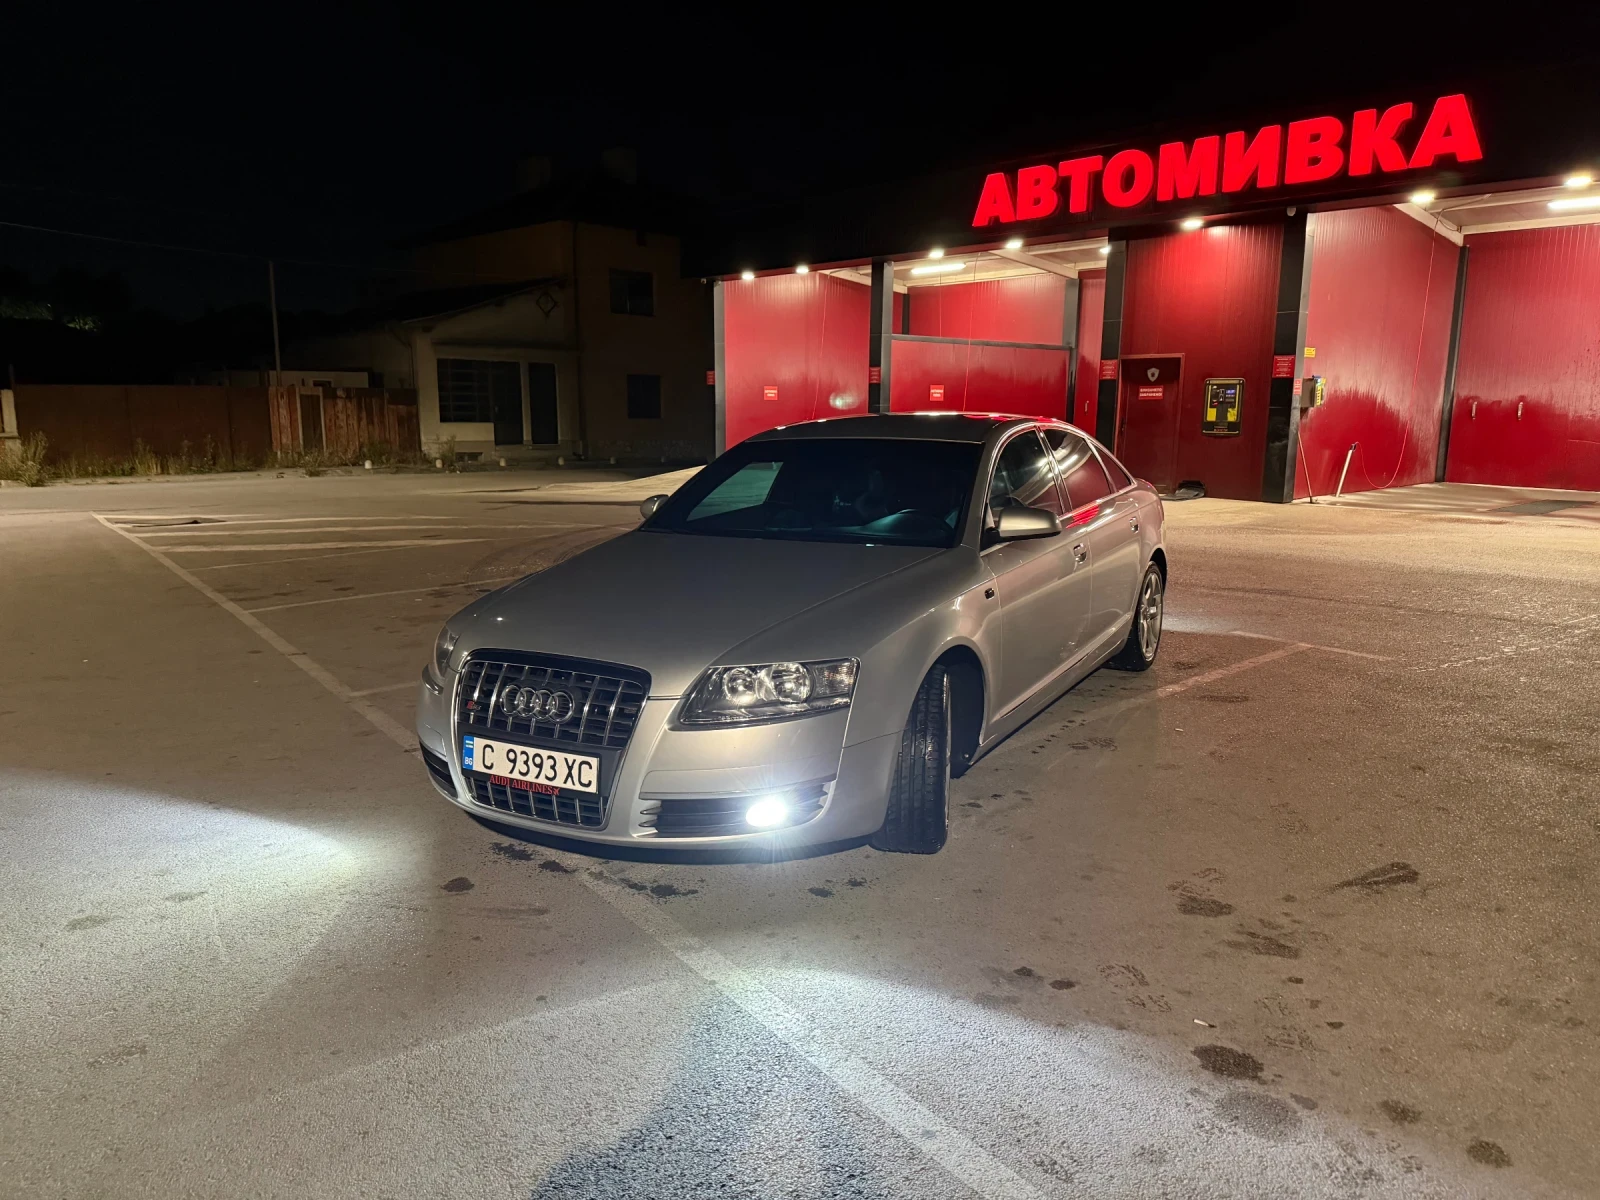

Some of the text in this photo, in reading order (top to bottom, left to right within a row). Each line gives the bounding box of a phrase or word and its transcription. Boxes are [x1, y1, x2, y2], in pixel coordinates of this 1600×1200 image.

[972, 93, 1484, 227] АВТОМИВКА
[464, 756, 473, 766] BG
[482, 744, 593, 788] C 9393 XC
[490, 774, 553, 795] AUDI AIRLINES
